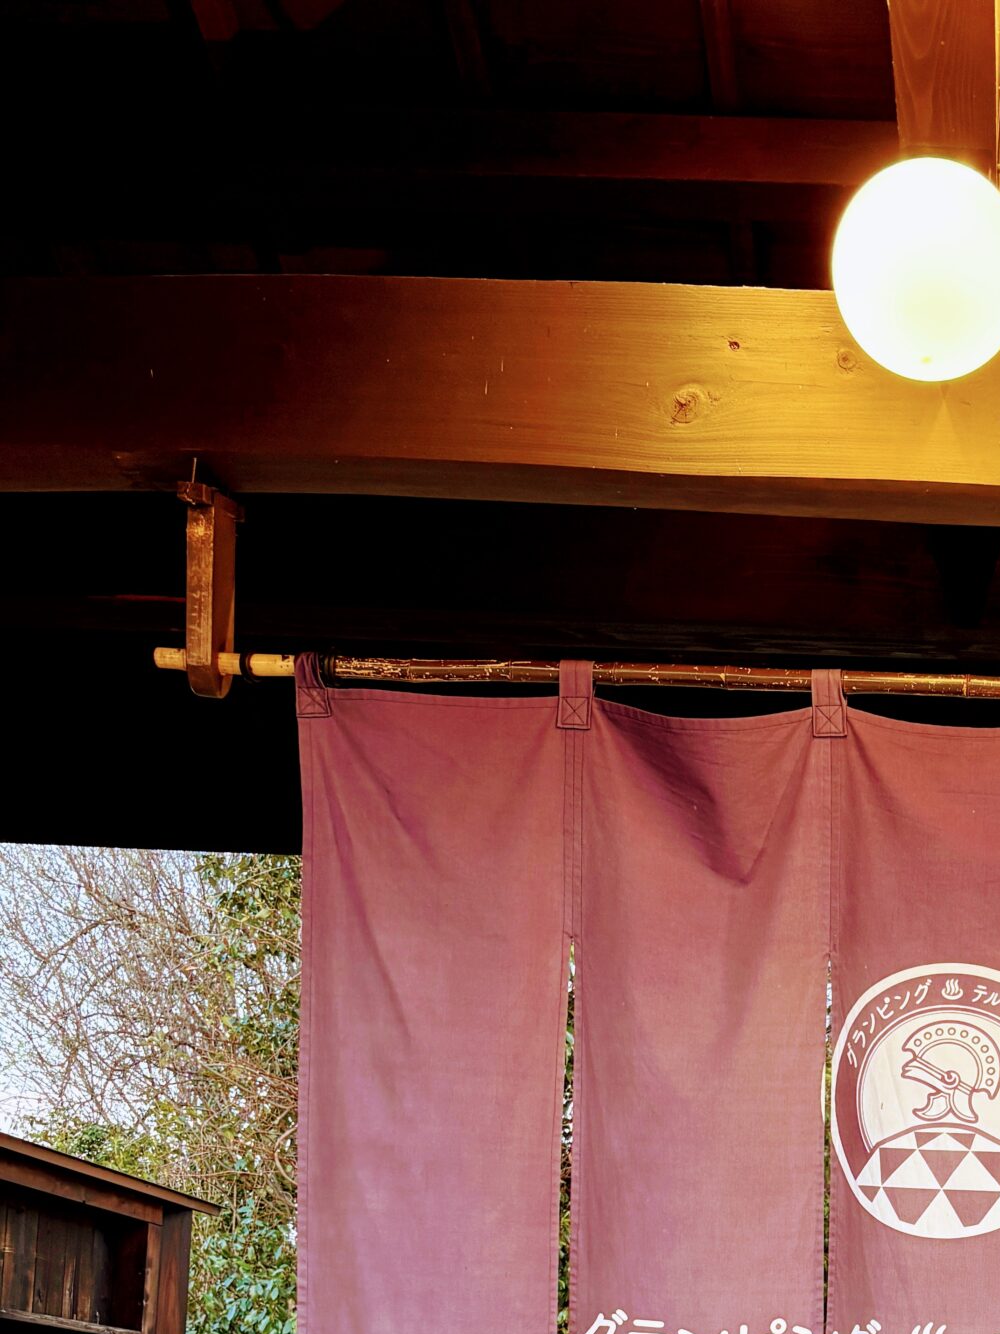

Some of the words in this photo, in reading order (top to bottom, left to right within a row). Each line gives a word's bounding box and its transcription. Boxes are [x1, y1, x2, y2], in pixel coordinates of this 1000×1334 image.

[847, 978, 932, 1068] グランピング
